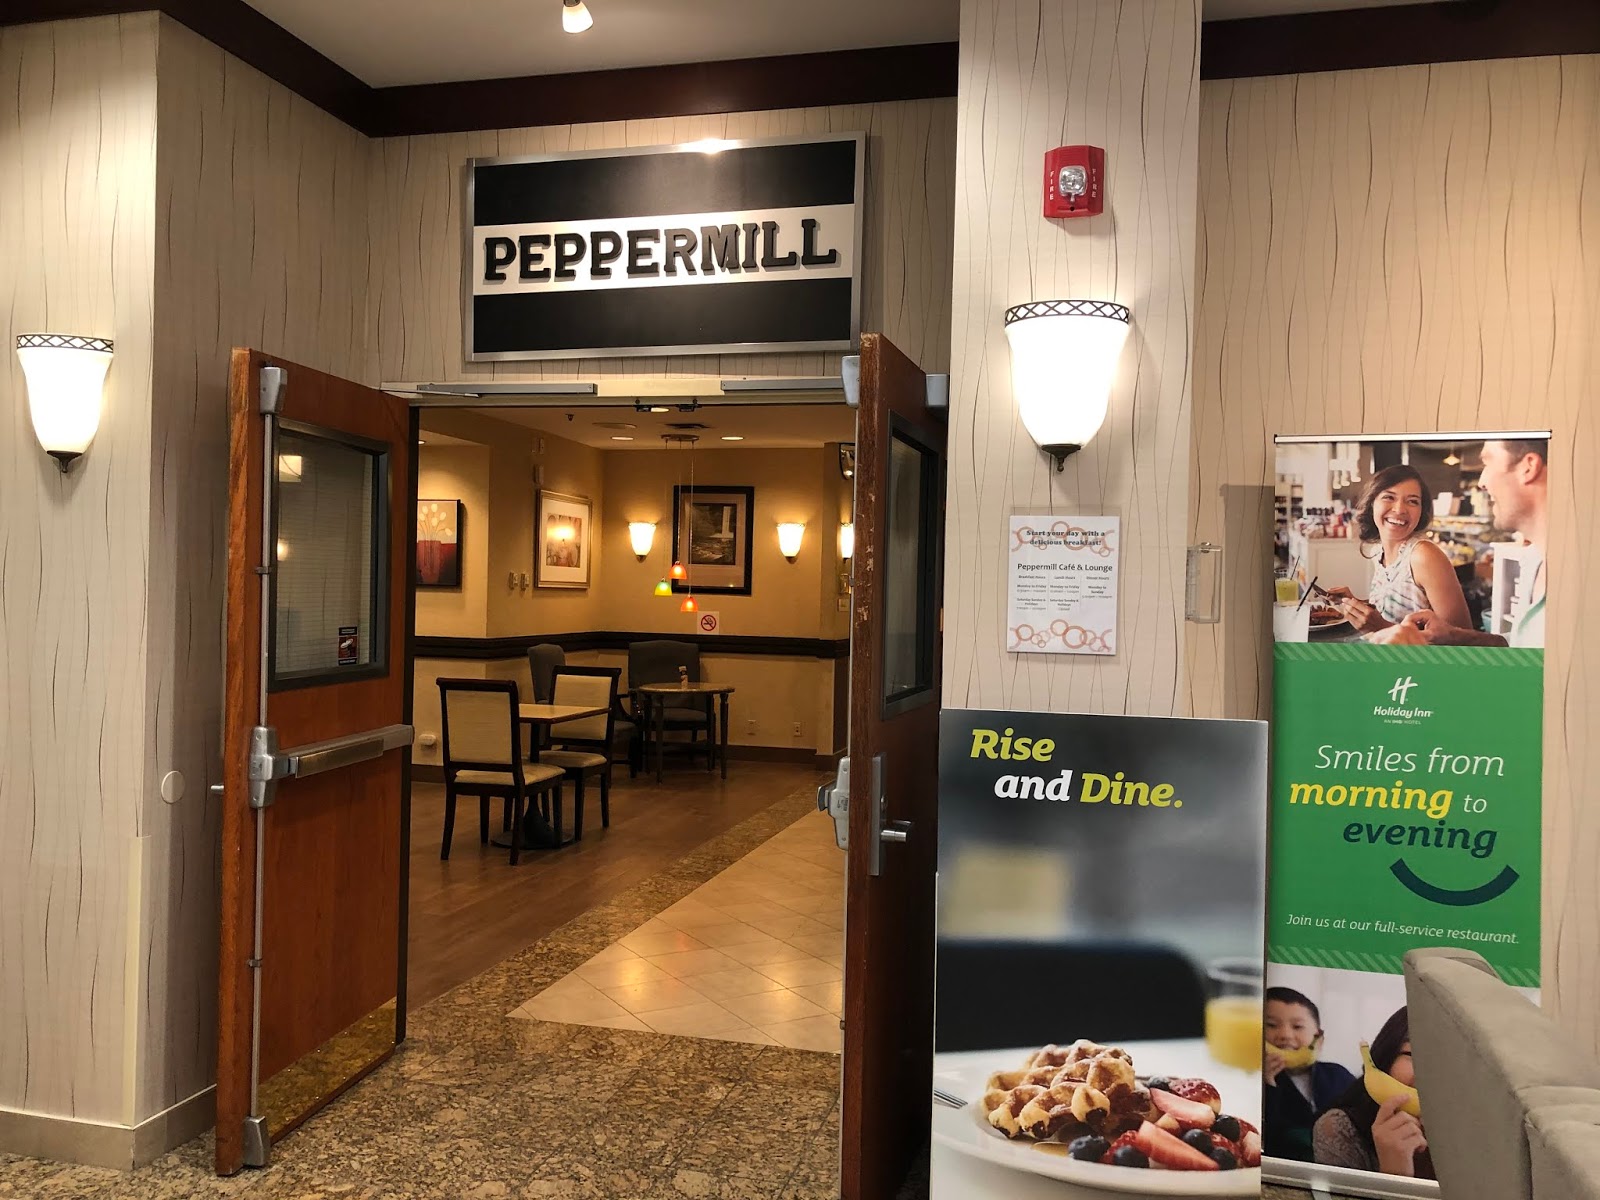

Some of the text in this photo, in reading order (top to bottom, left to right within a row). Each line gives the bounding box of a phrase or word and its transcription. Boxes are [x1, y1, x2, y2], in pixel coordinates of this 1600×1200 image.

[483, 218, 837, 281] PEPPERMILL
[1017, 563, 1057, 571] Peppermill
[1059, 563, 1076, 571] Café
[1084, 564, 1113, 573] Lounge
[1373, 706, 1433, 719] Holiday Inn
[970, 727, 1055, 762] Rise
[1314, 744, 1505, 777] Smiles from
[994, 769, 1183, 808] and Dine.
[1289, 780, 1488, 819] morning to
[1343, 819, 1498, 859] evening
[1286, 914, 1520, 945] Join us at our full-service restaurant.
